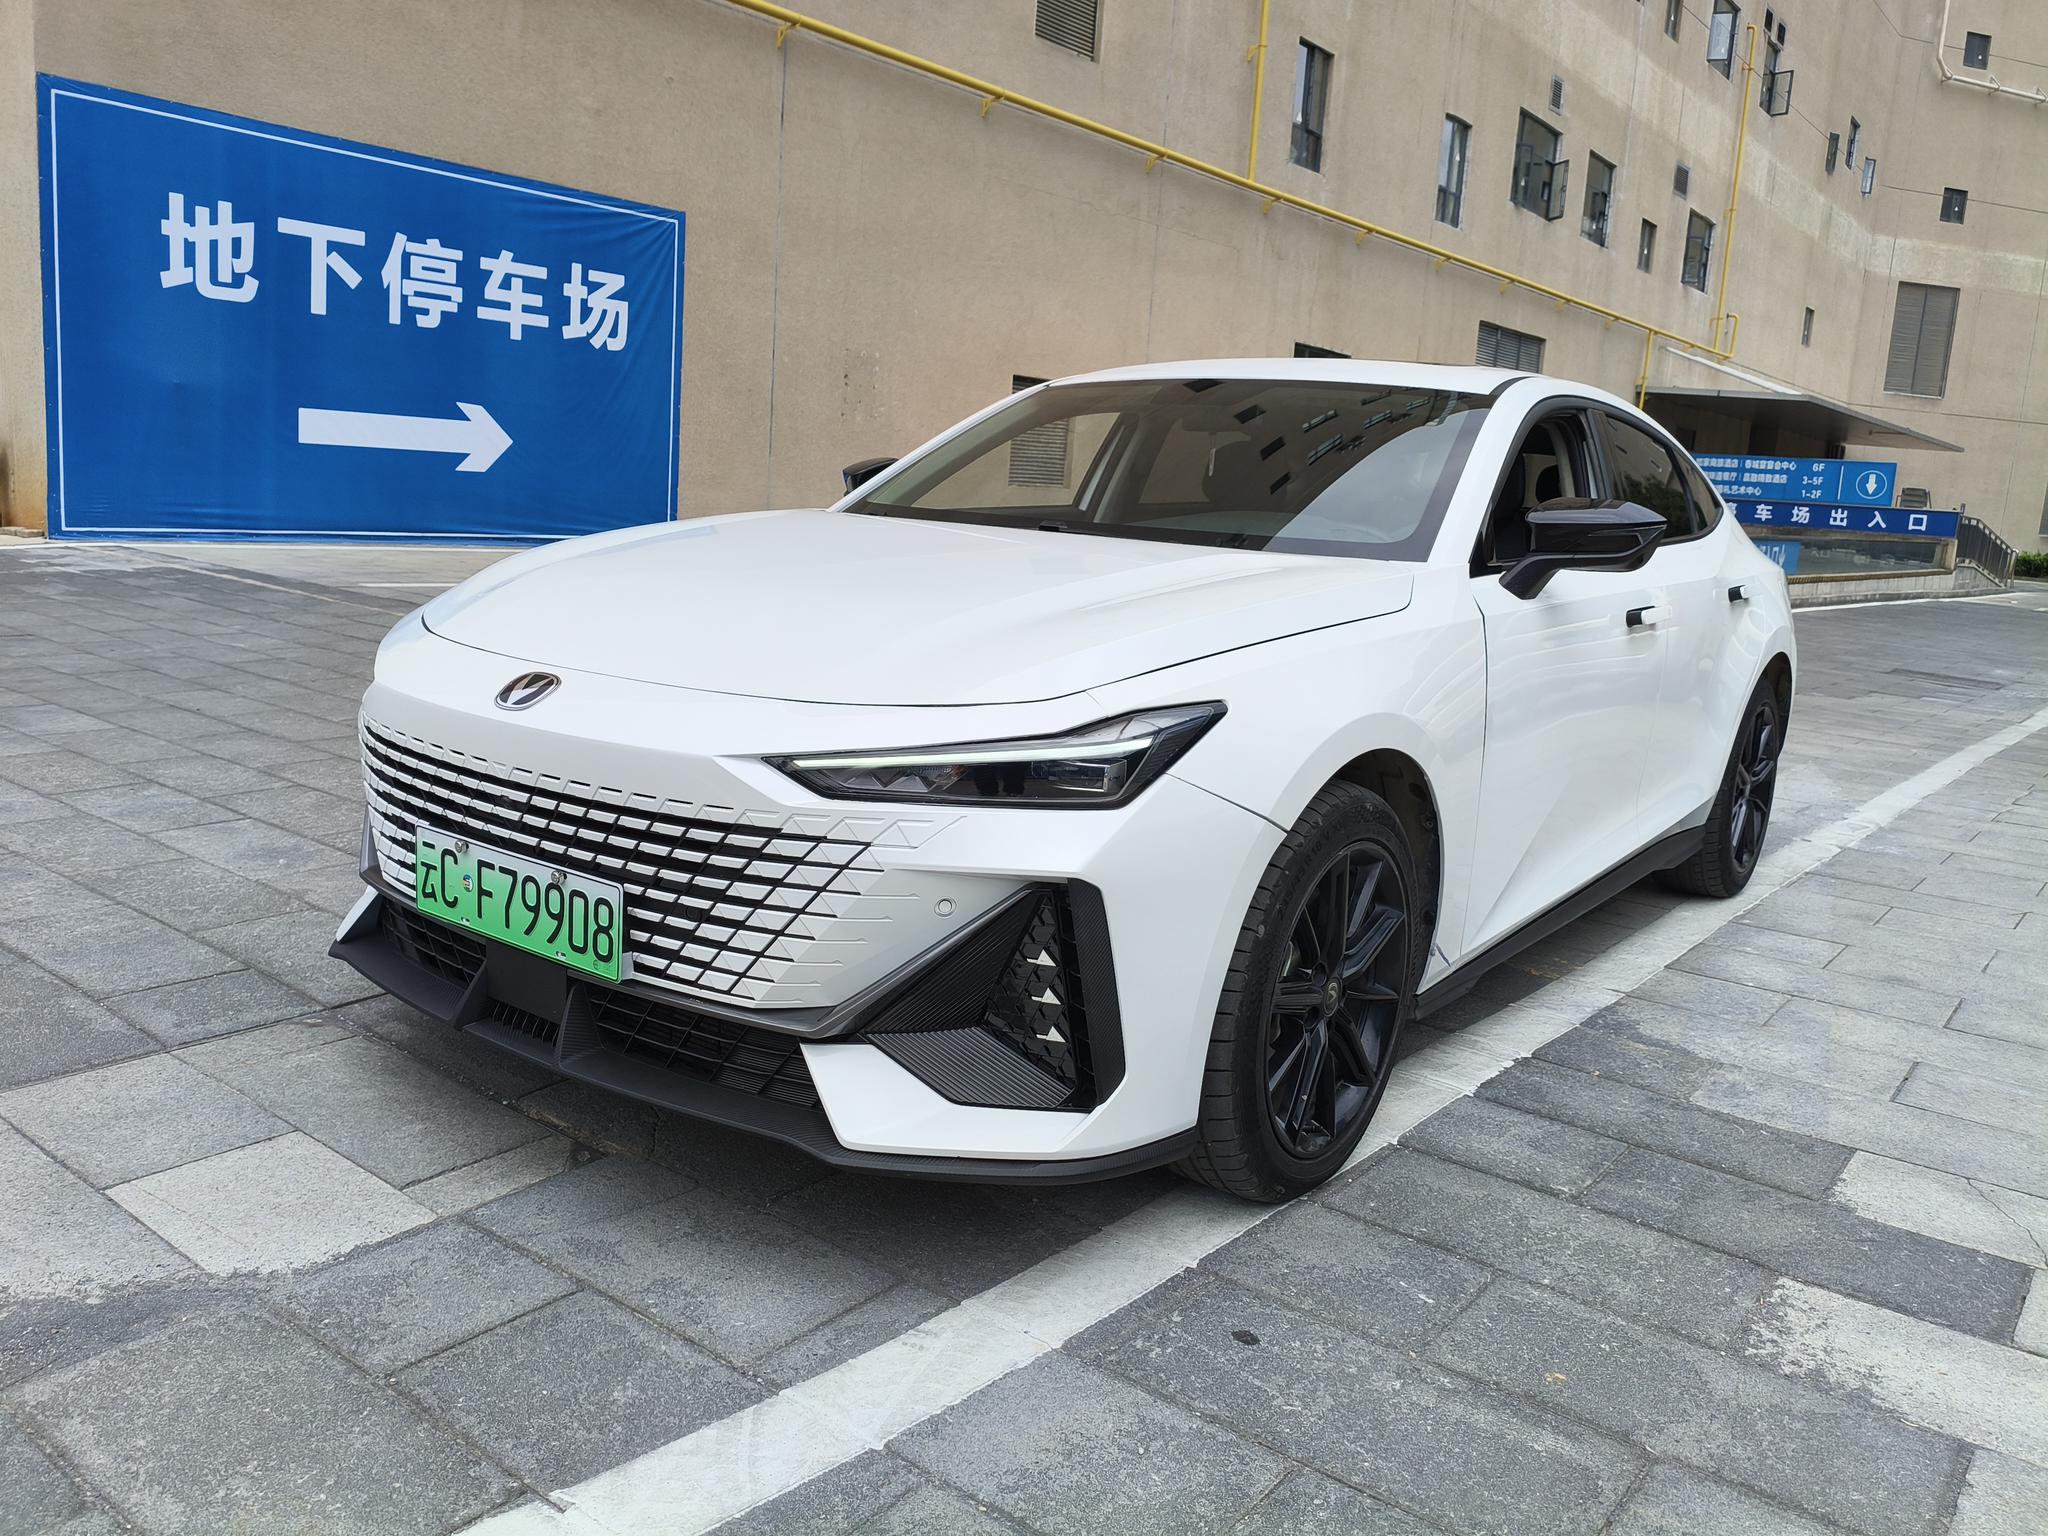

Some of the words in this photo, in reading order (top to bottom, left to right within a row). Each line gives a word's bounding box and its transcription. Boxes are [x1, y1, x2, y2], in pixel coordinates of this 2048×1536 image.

[160, 191, 629, 351] 地下停车场
[1812, 463, 1826, 472] 6F
[1802, 476, 1824, 486] 3-5F
[1801, 489, 1822, 499] 1-2F
